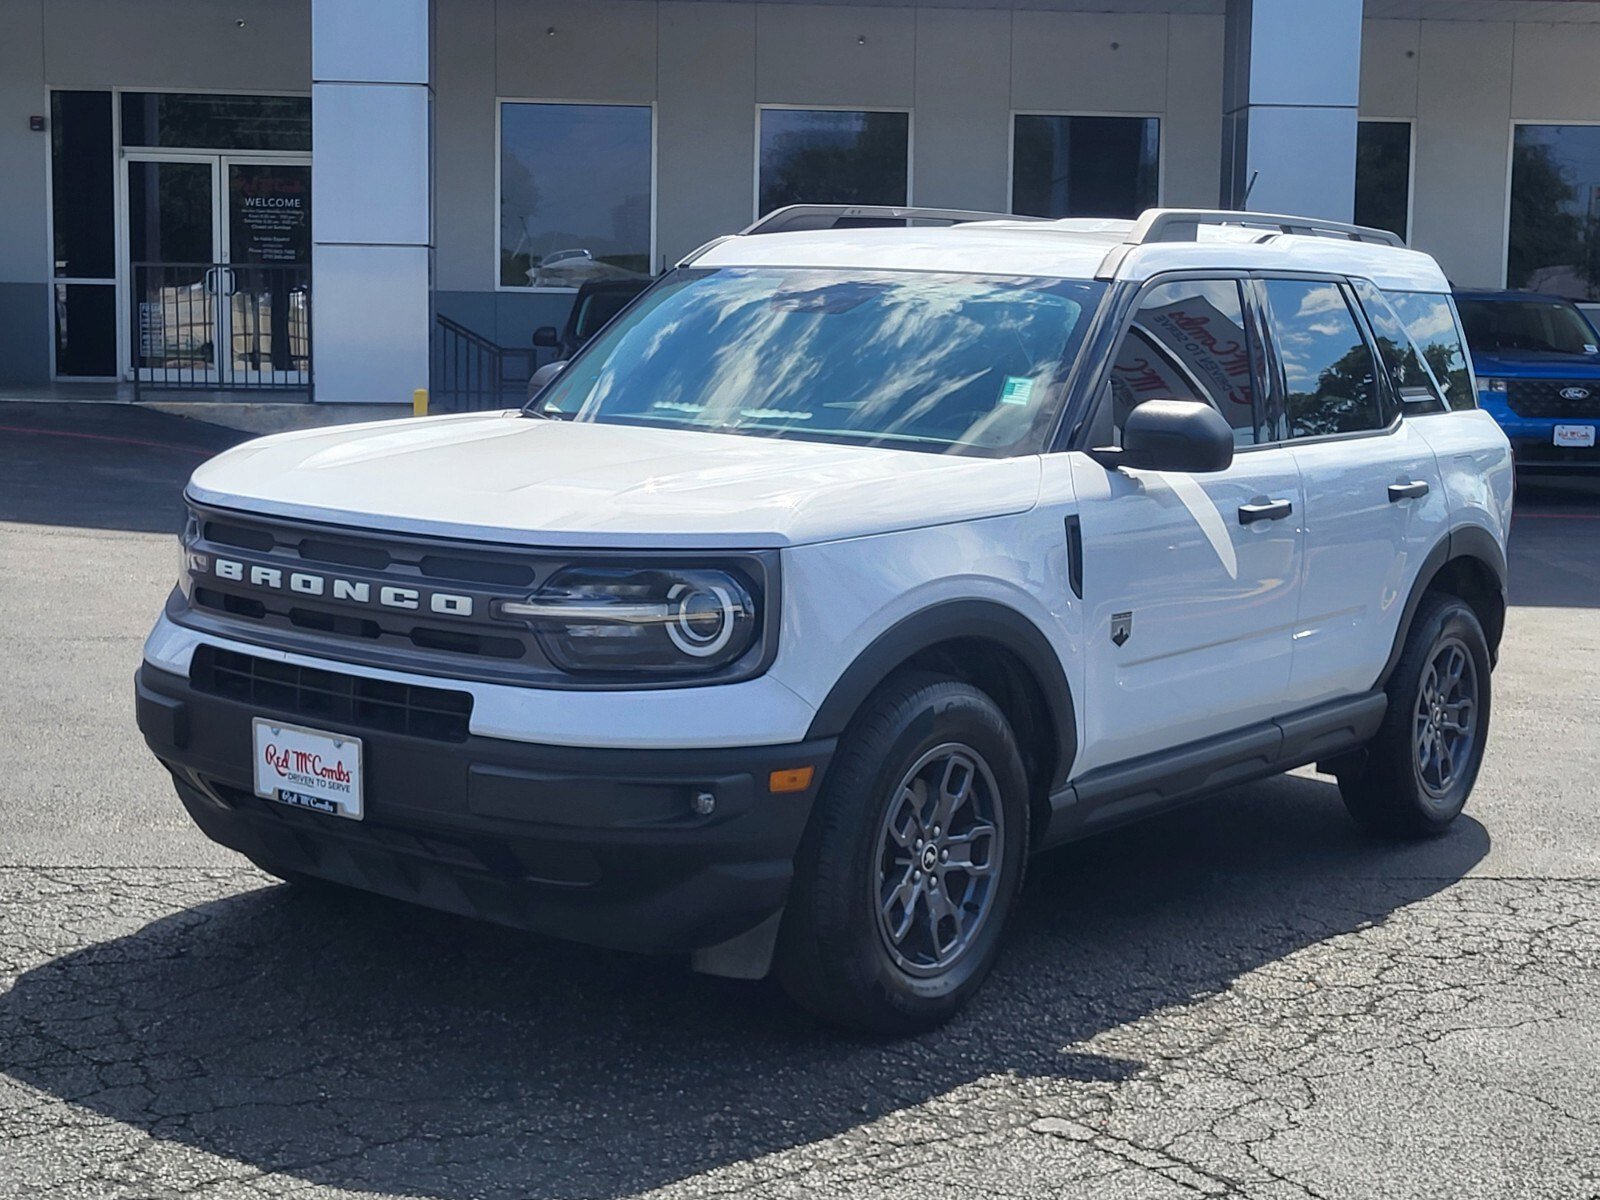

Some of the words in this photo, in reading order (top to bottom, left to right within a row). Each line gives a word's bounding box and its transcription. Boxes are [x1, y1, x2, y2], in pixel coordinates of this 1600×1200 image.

[244, 197, 301, 208] WELCOME
[214, 558, 473, 617] BRONCO
[265, 744, 290, 777] Red
[287, 772, 315, 786] DRIVEN
[316, 778, 327, 788] TO
[328, 781, 351, 793] SERVE
